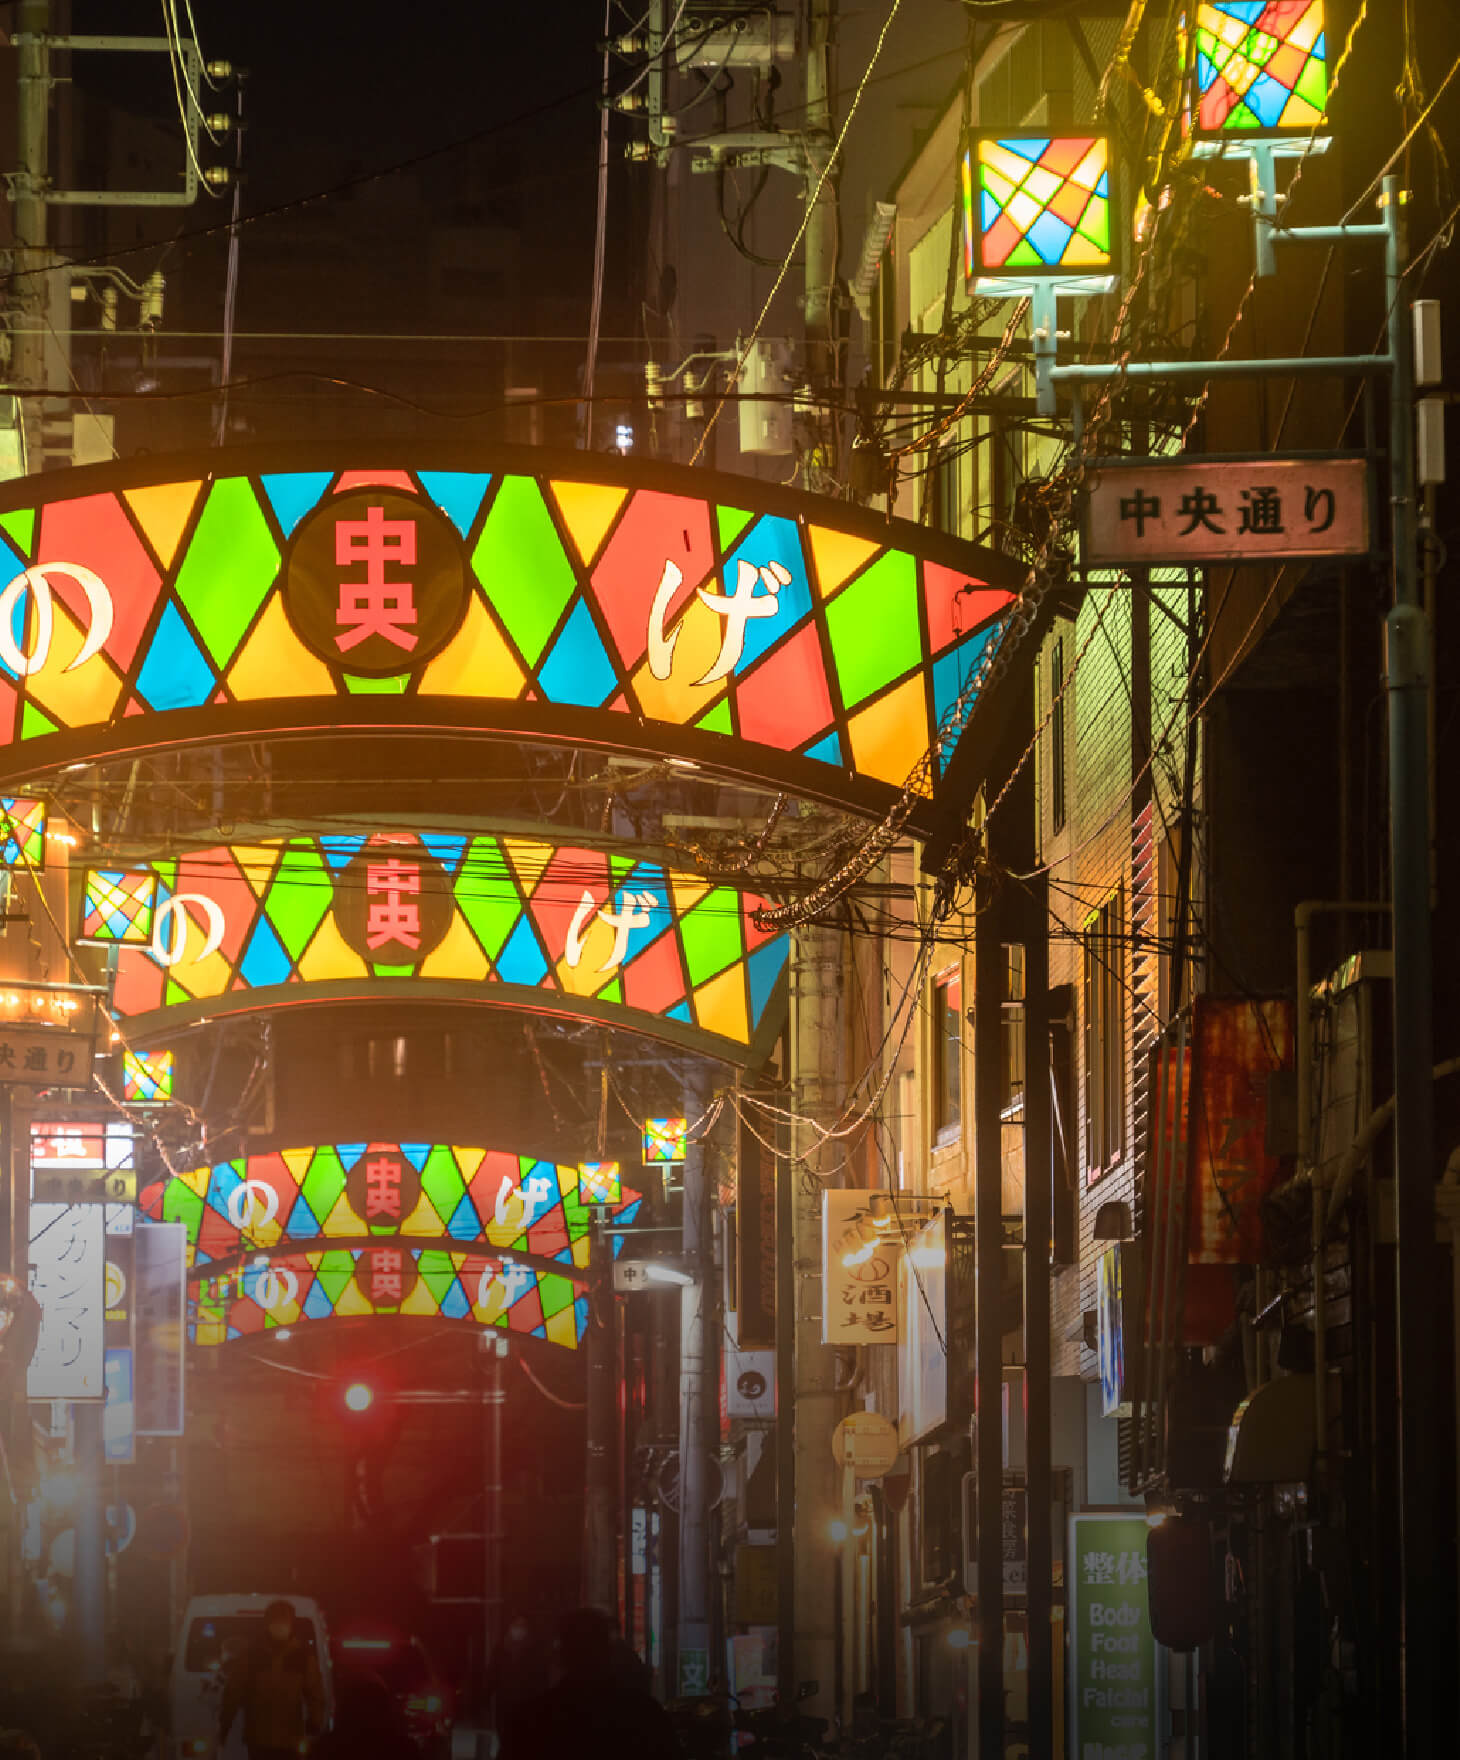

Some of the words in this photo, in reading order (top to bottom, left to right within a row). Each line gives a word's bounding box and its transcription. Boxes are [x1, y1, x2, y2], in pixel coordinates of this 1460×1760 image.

[1121, 485, 1337, 539] 中央通り
[334, 506, 420, 654] 中央
[0, 561, 115, 675] の
[646, 558, 792, 686] げ
[150, 892, 226, 967] の
[565, 889, 659, 973] げ
[367, 858, 421, 952] 中央
[227, 1180, 279, 1231] の
[494, 1175, 552, 1229] げ
[366, 1157, 402, 1218] 中央
[255, 1266, 299, 1309] の
[370, 1250, 402, 1299] 中央
[1083, 1551, 1148, 1585] 整体
[1089, 1602, 1141, 1627] Body
[1091, 1632, 1140, 1653] Foot
[1091, 1659, 1141, 1680] Head
